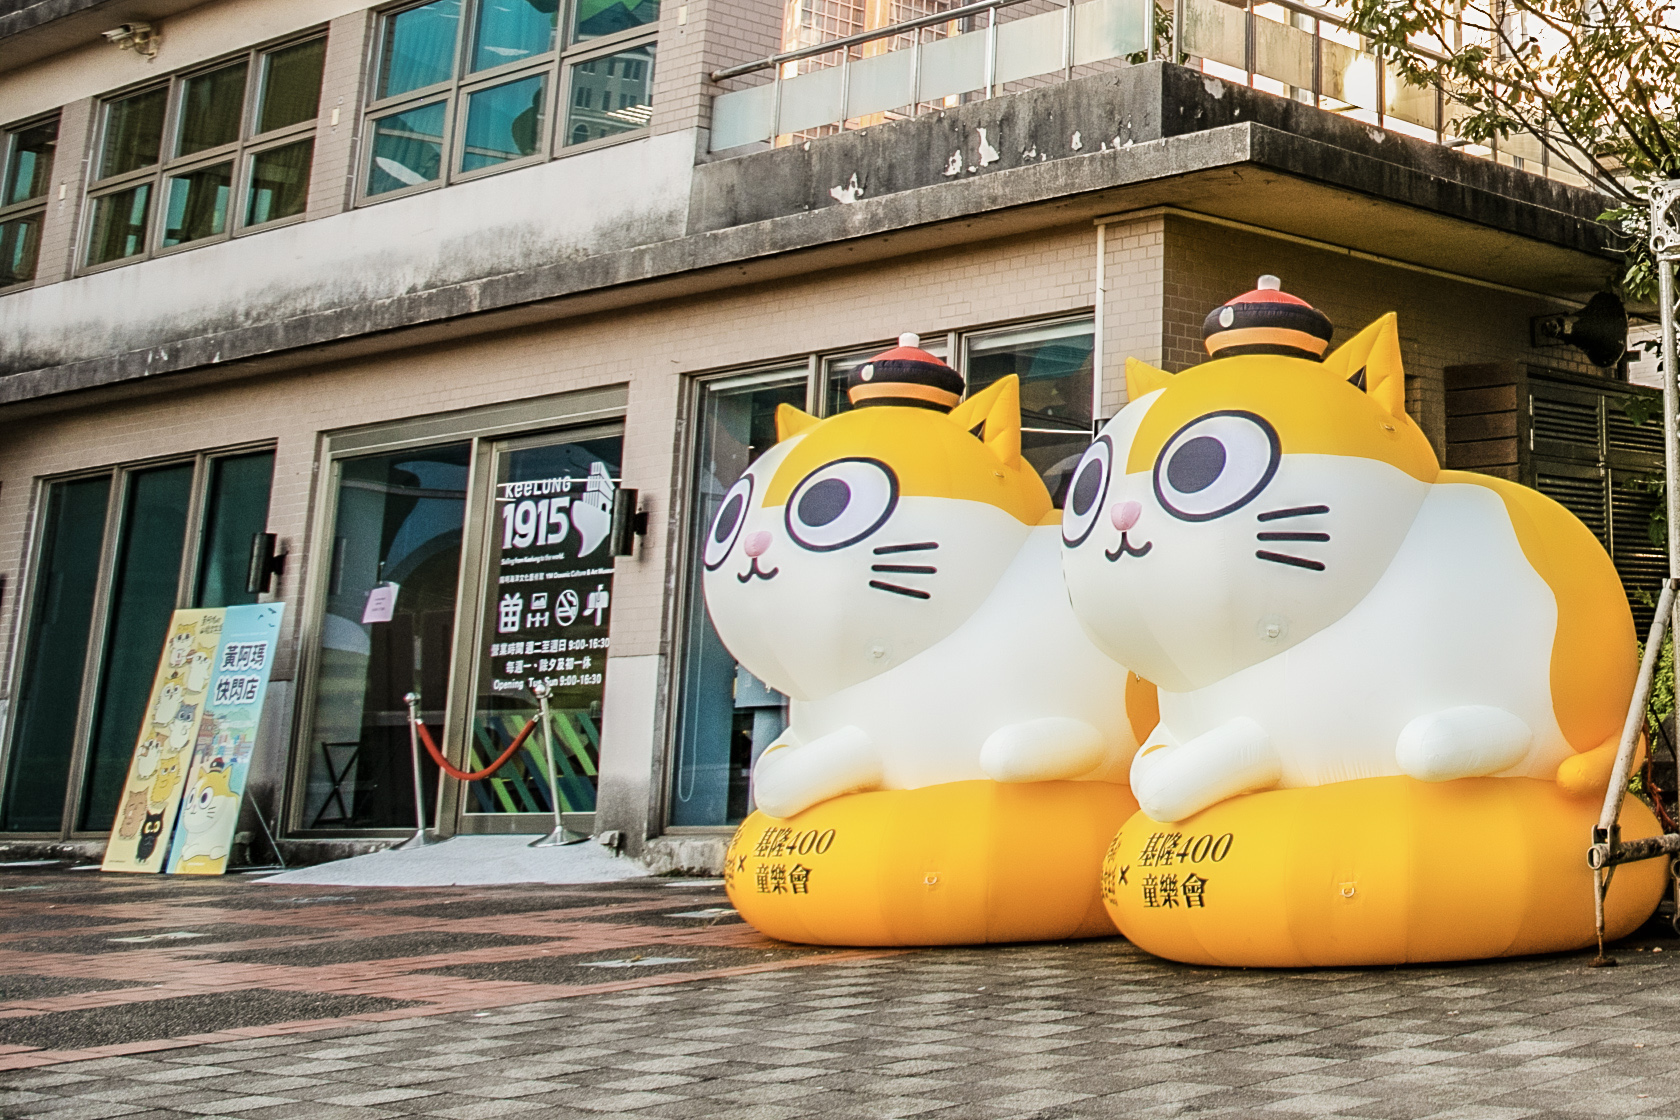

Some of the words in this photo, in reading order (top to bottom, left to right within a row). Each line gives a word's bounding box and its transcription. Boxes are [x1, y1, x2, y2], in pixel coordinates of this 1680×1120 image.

[502, 496, 571, 549] 1915
[222, 643, 267, 668] 黃阿瑪
[568, 637, 610, 650] 9:00-16:30
[215, 677, 260, 701] 快閃店
[493, 678, 524, 691] Opening
[559, 673, 602, 687] 9:00-16:30
[753, 826, 837, 858] 基隆400
[1137, 831, 1234, 868] 基隆400
[755, 862, 813, 895] 童樂會
[1141, 871, 1210, 909] 童樂會
